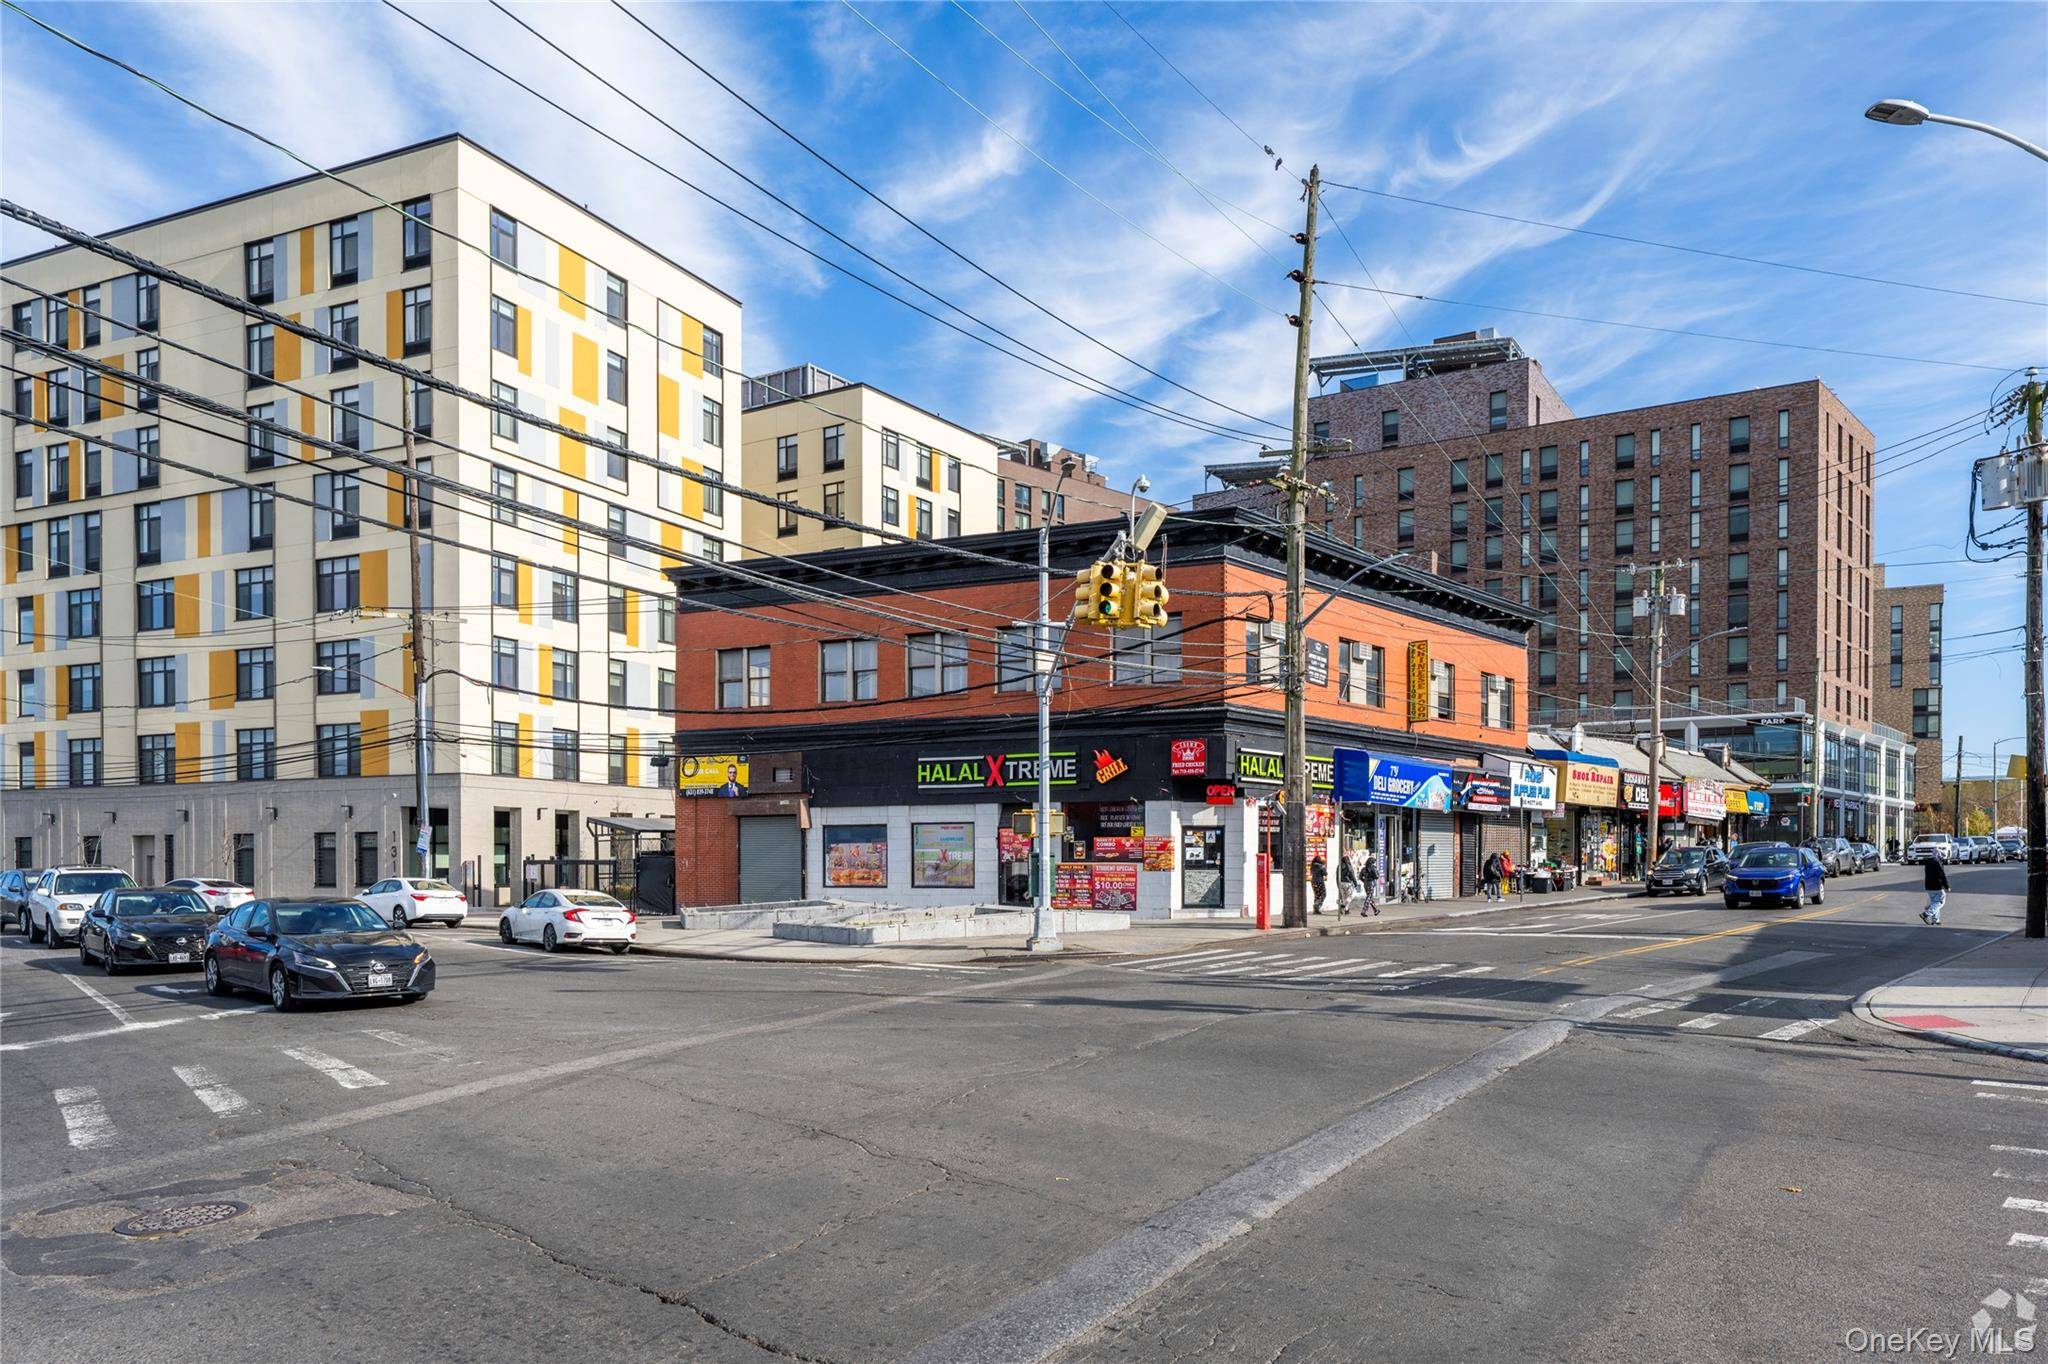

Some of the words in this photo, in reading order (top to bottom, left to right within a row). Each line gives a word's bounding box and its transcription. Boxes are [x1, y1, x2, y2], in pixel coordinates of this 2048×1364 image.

[918, 762, 985, 783] HALAL
[1096, 758, 1128, 784] GRILL
[1241, 754, 1285, 778] HALAL
[1374, 775, 1387, 791] DELI
[1388, 777, 1415, 795] GROCERY
[1572, 769, 1590, 782] SHOE
[1590, 771, 1614, 785] REPAIR
[1206, 785, 1236, 797] OPEN
[1095, 882, 1123, 890] $10.00
